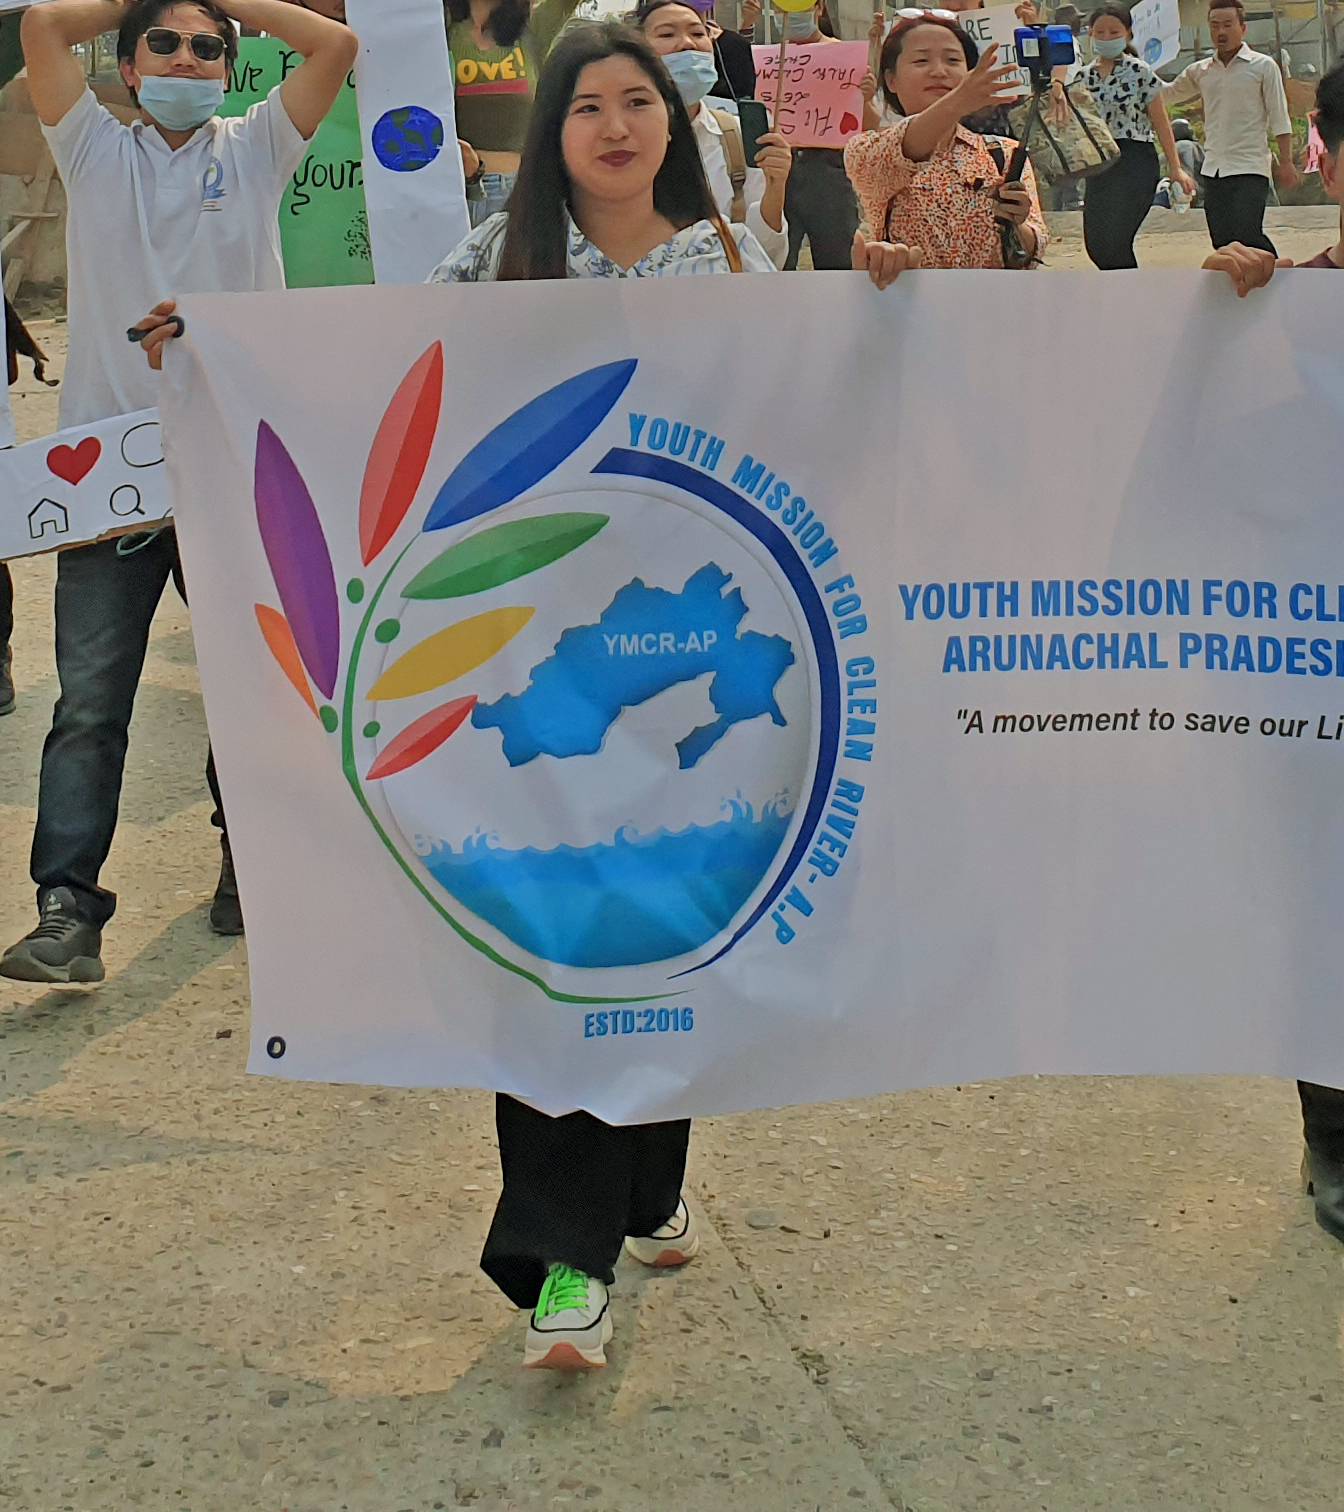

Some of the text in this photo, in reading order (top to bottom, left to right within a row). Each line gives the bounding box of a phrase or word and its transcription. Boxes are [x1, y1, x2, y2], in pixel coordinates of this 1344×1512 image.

[457, 47, 525, 84] OVE!
[629, 413, 726, 471] YOUTH
[730, 454, 839, 569] MISSION
[824, 573, 868, 640] FOR
[898, 581, 1020, 621] YOUTH
[1031, 579, 1191, 617] MISSION
[1202, 580, 1278, 620] FOR
[603, 630, 717, 656] YMCR-AP
[941, 633, 1168, 673] ARUNACHAL
[843, 655, 877, 762] CLEAN
[956, 709, 986, 736] "A
[992, 709, 1141, 735] movement
[1147, 708, 1176, 732] to
[1183, 712, 1251, 735] save
[1258, 716, 1308, 740] our
[583, 1006, 694, 1039] ESTD:2016
